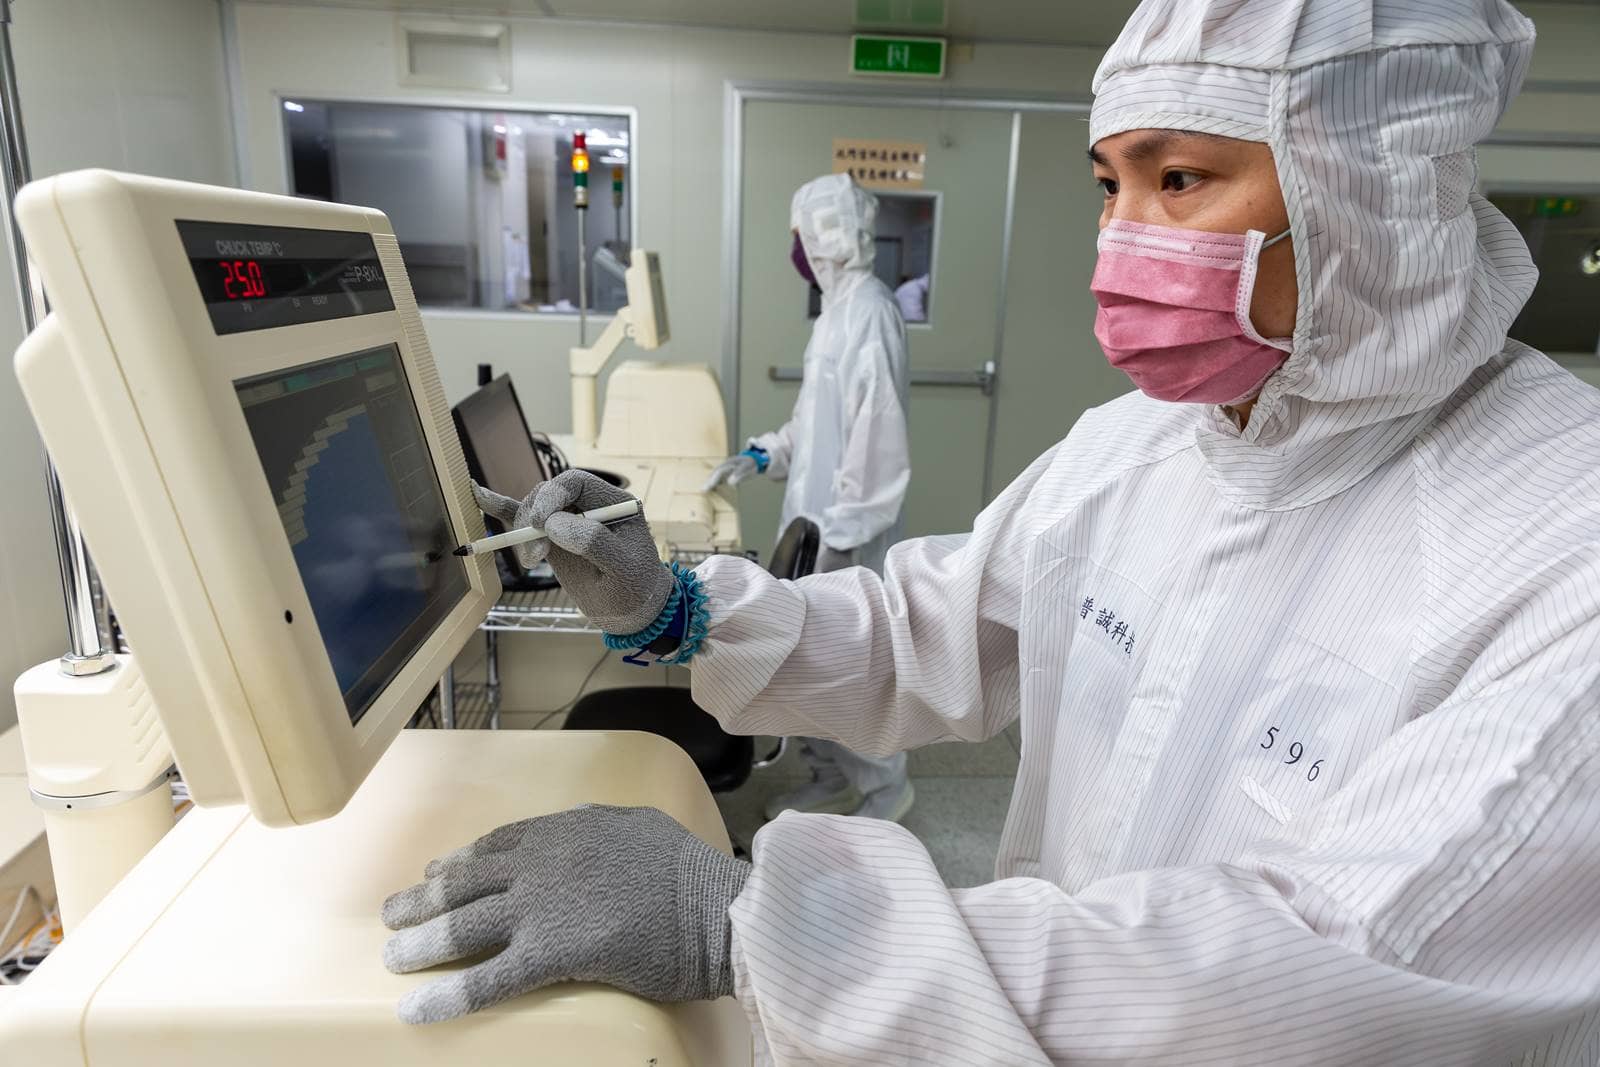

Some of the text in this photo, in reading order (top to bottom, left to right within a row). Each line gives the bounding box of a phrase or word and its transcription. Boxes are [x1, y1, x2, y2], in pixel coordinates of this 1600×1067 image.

[216, 240, 249, 256] CHUCK
[249, 241, 273, 256] TEMP
[1260, 726, 1325, 782] 596
